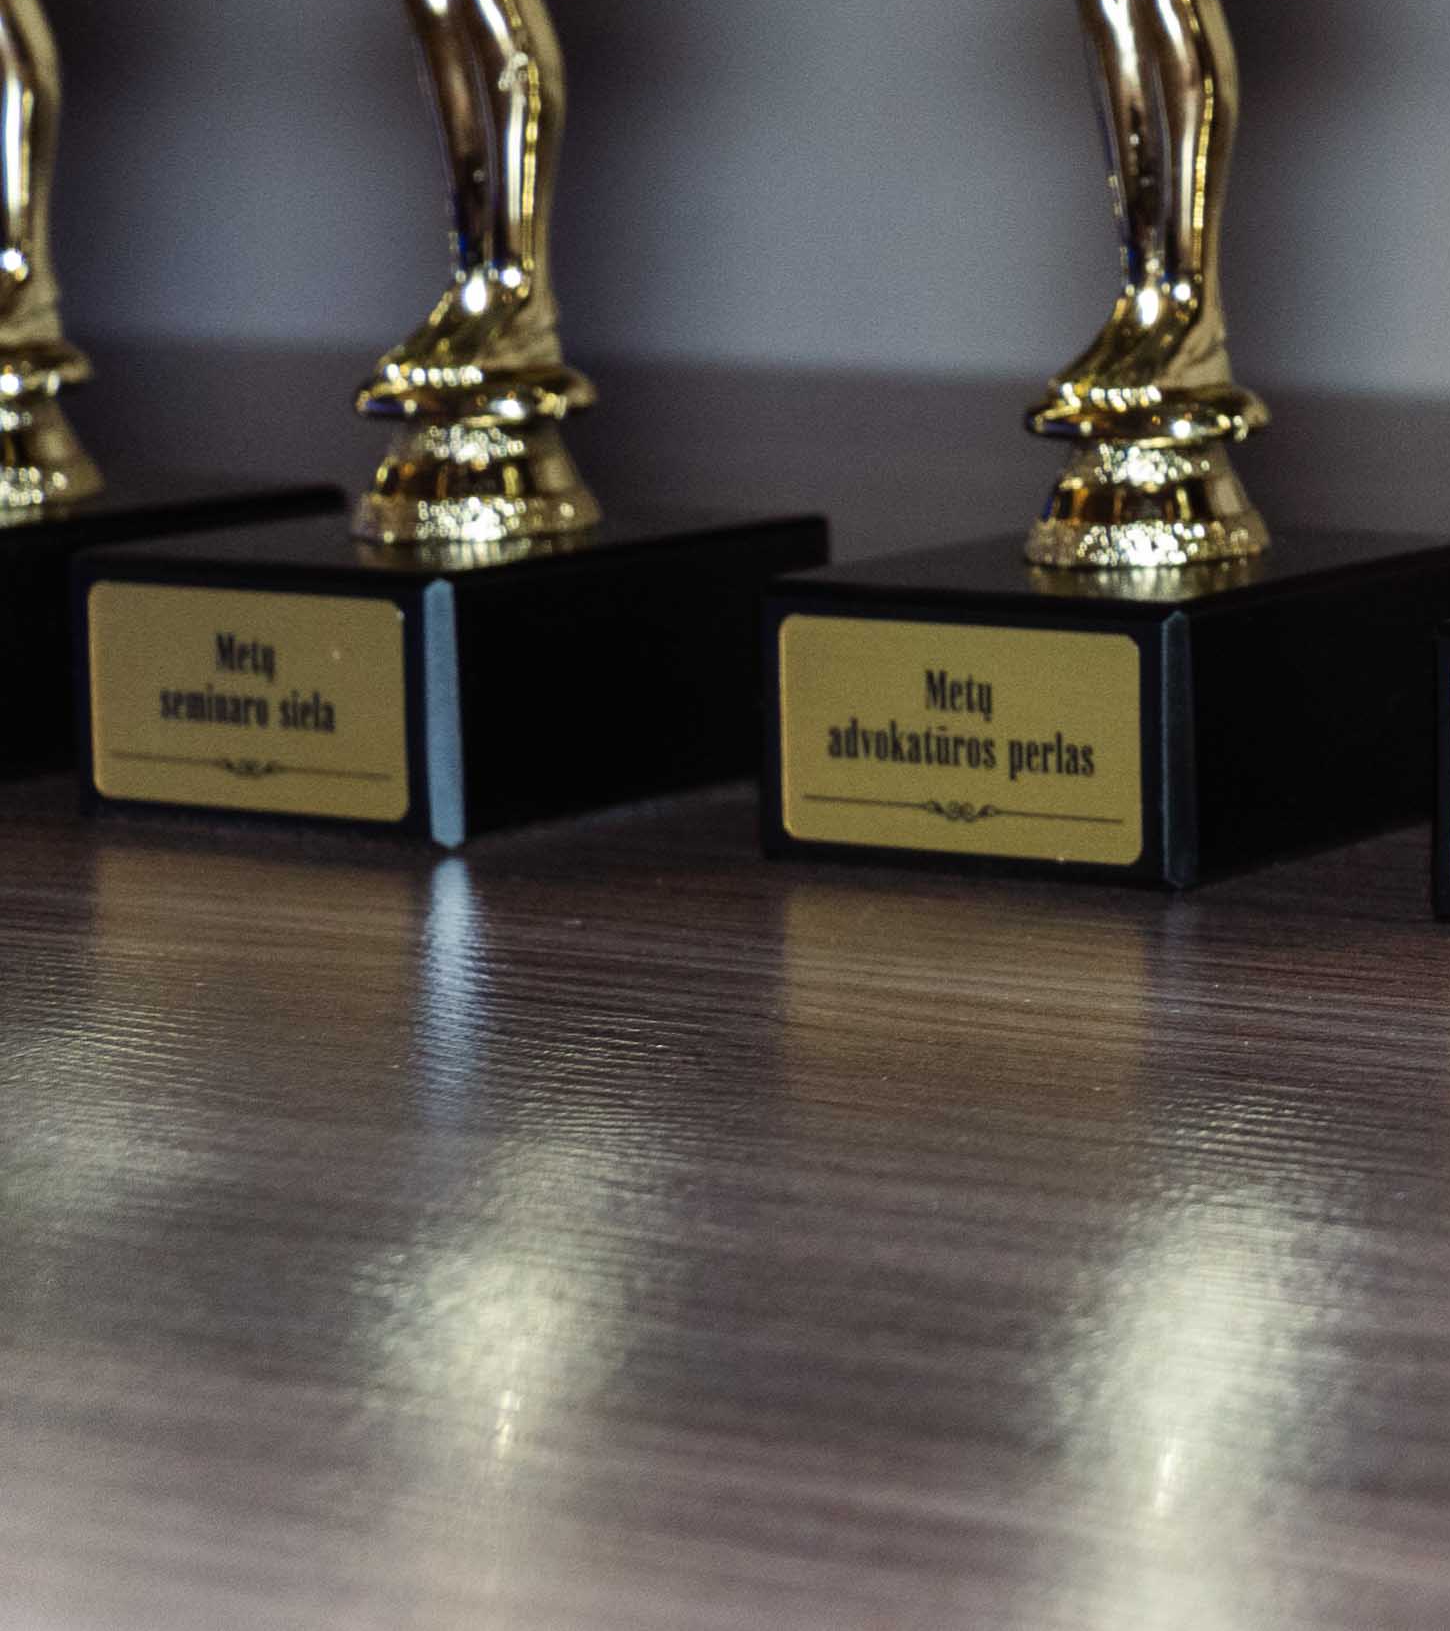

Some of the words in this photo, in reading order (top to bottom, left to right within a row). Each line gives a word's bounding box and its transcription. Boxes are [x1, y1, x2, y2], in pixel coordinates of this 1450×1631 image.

[216, 632, 276, 682] Metų
[160, 684, 269, 729] seminaro
[280, 689, 336, 733] siela
[925, 669, 992, 722] Metų
[828, 717, 996, 769] advokatūros
[1008, 731, 1094, 780] perlas
